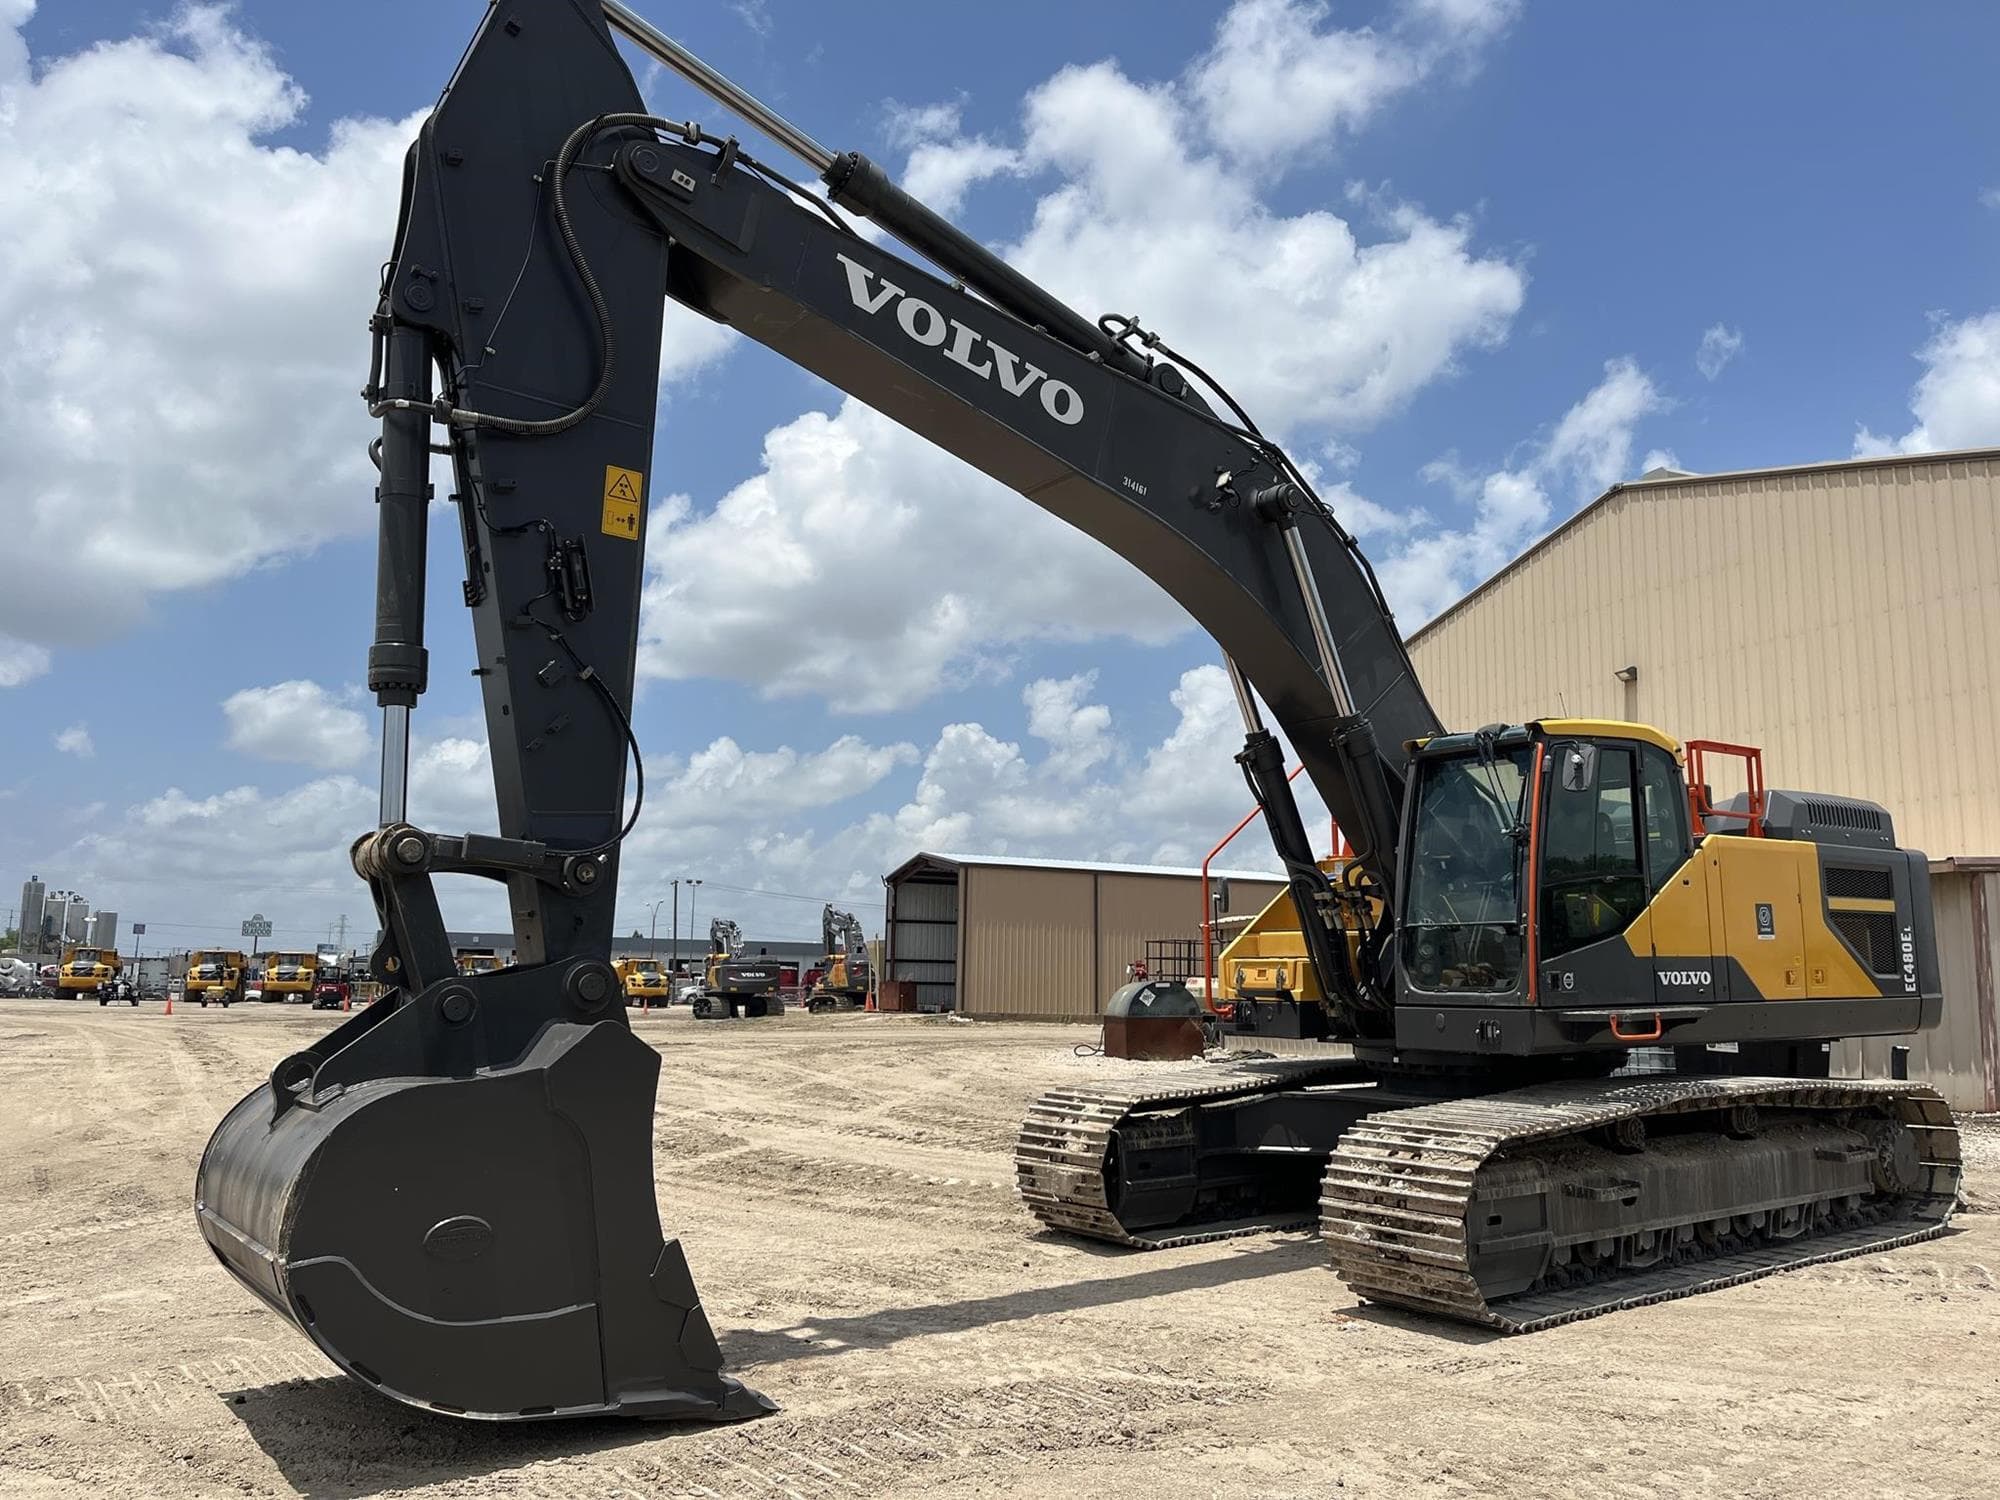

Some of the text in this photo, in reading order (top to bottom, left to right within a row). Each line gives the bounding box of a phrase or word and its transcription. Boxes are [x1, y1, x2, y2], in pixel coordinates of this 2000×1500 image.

[837, 253, 1084, 425] VOLVO
[1122, 476, 1148, 496] 314161
[1657, 971, 1711, 985] VOLVO
